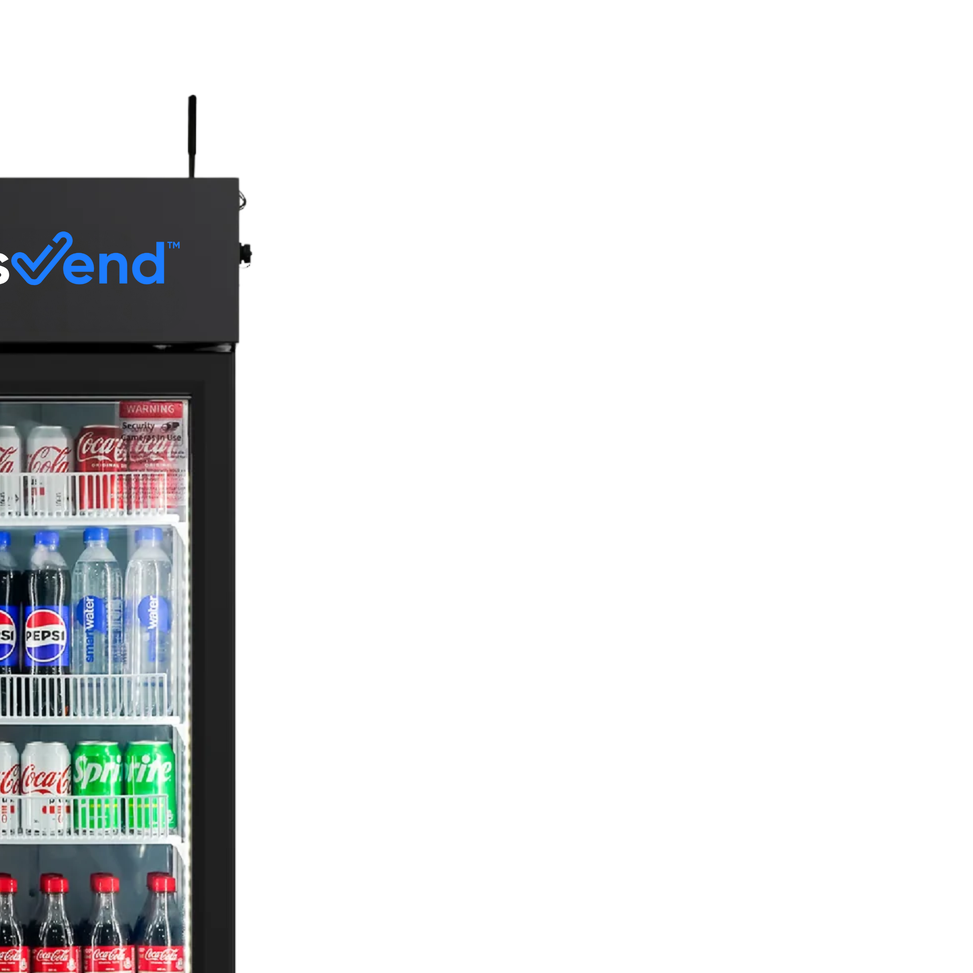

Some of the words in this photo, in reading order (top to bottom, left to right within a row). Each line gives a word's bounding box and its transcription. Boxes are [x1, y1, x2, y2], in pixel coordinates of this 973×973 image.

[127, 404, 174, 414] WARNING
[122, 421, 155, 432] Security
[167, 434, 182, 442] Use
[74, 754, 122, 789] Spri
[126, 753, 172, 783] rite
[36, 949, 70, 961] Coca-Cola
[92, 948, 127, 961] Coca-Cola
[144, 948, 178, 961] Coca-Cola
